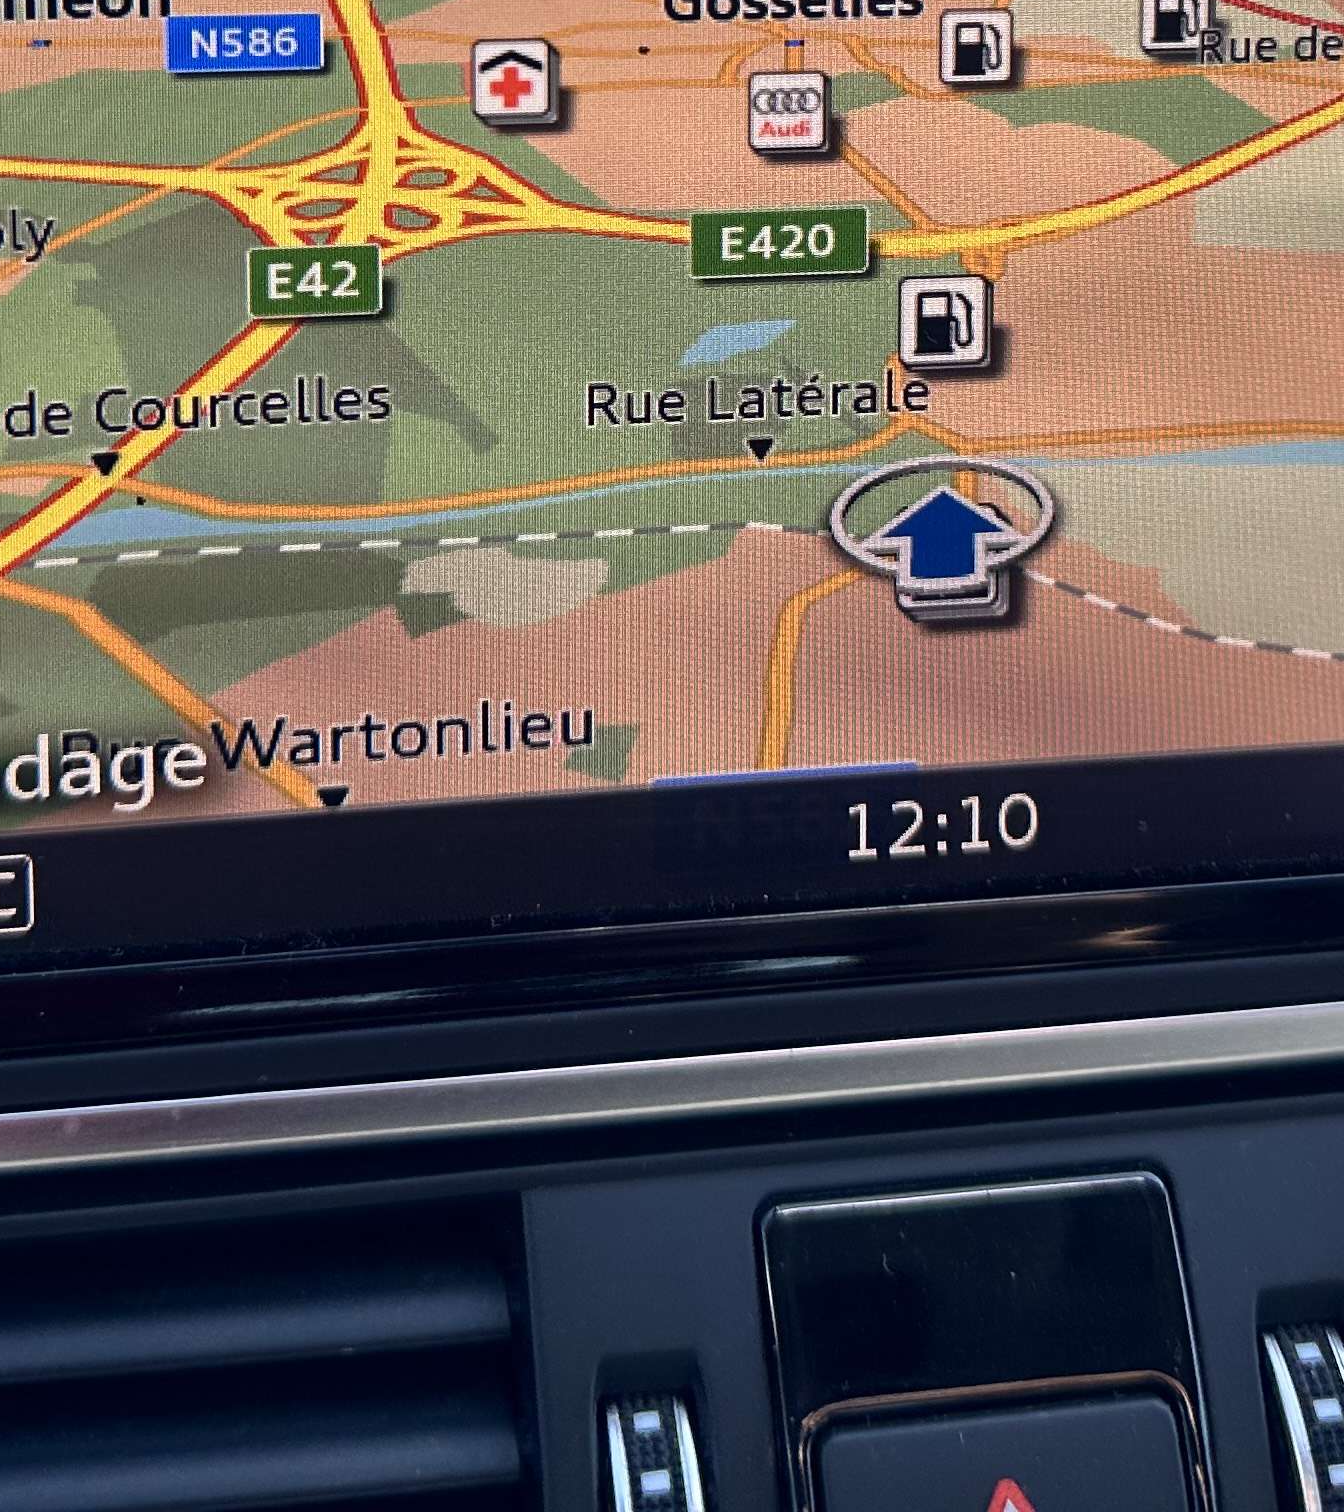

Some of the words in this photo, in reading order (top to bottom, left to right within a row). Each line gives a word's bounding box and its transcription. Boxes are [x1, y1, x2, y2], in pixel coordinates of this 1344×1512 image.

[190, 26, 298, 58] N586
[1200, 29, 1283, 65] Rue
[758, 119, 811, 138] Audi
[721, 224, 835, 260] E420
[266, 261, 360, 300] E42
[4, 390, 71, 438] de
[96, 376, 393, 433] Courcelles
[586, 383, 686, 426] Rue
[707, 369, 930, 421] Latérale
[211, 698, 595, 771] Wartonlieu
[847, 792, 1040, 860] 12:10
